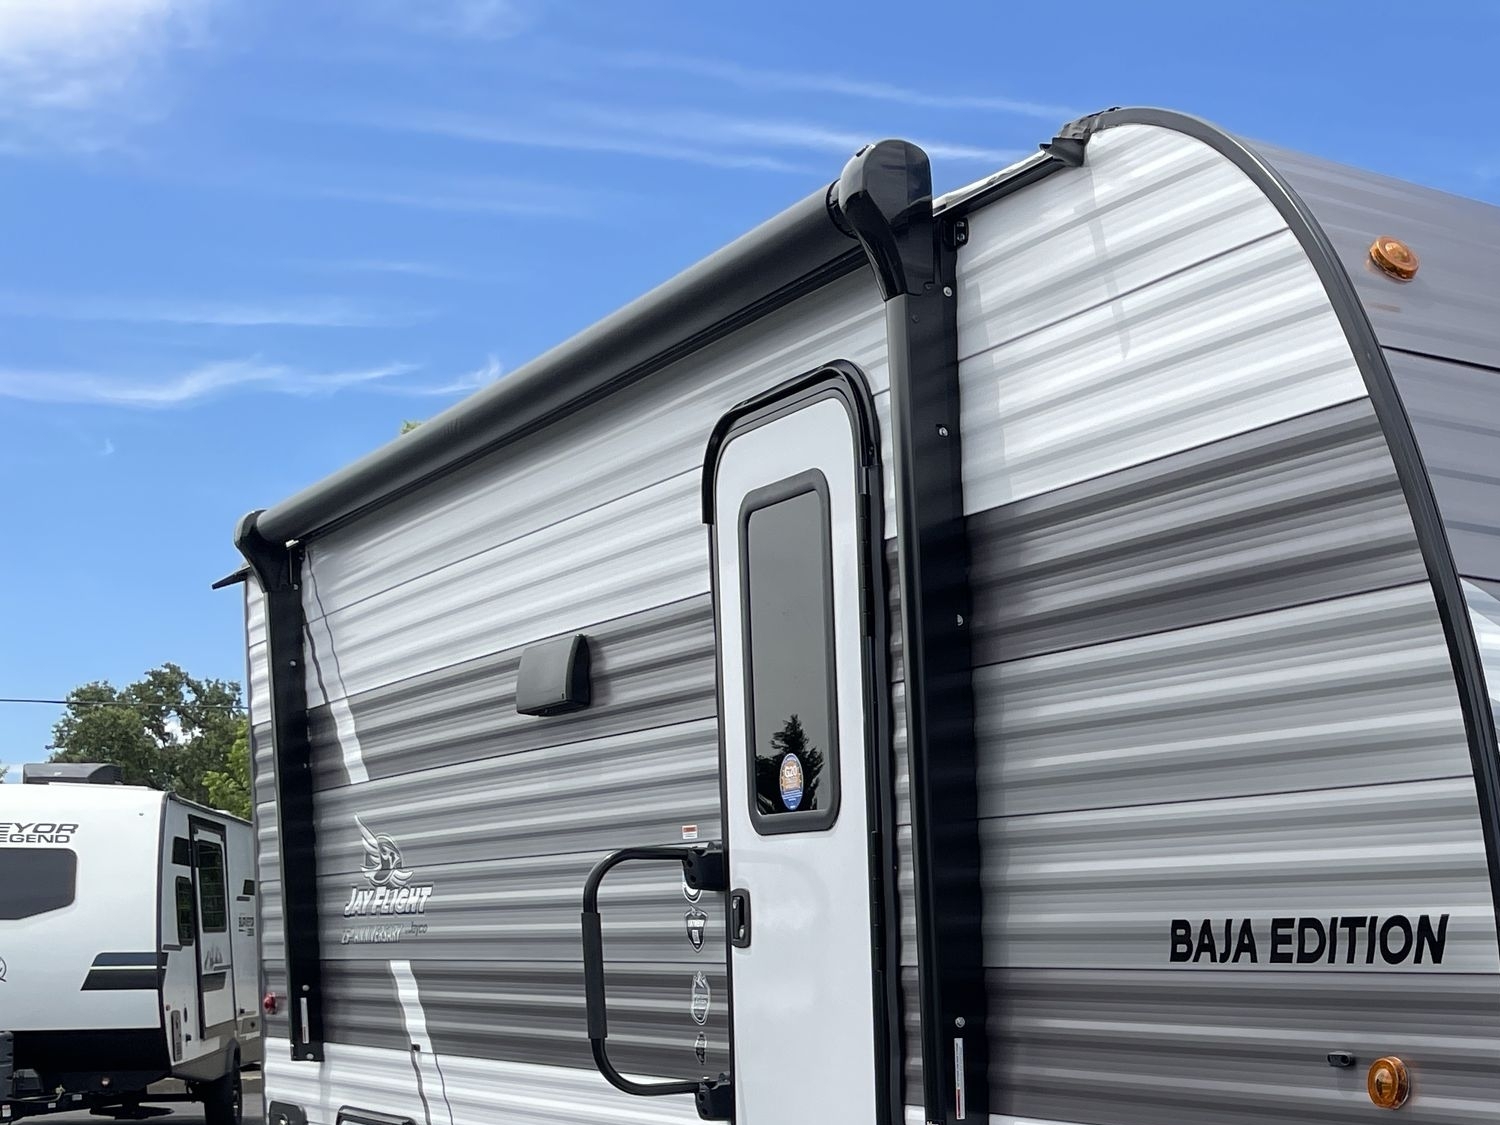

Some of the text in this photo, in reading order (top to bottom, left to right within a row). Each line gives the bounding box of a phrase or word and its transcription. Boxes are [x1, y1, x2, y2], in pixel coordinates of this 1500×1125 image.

[344, 885, 434, 917] JAY FLIGHT
[1169, 914, 1450, 965] BAJA EDITION
